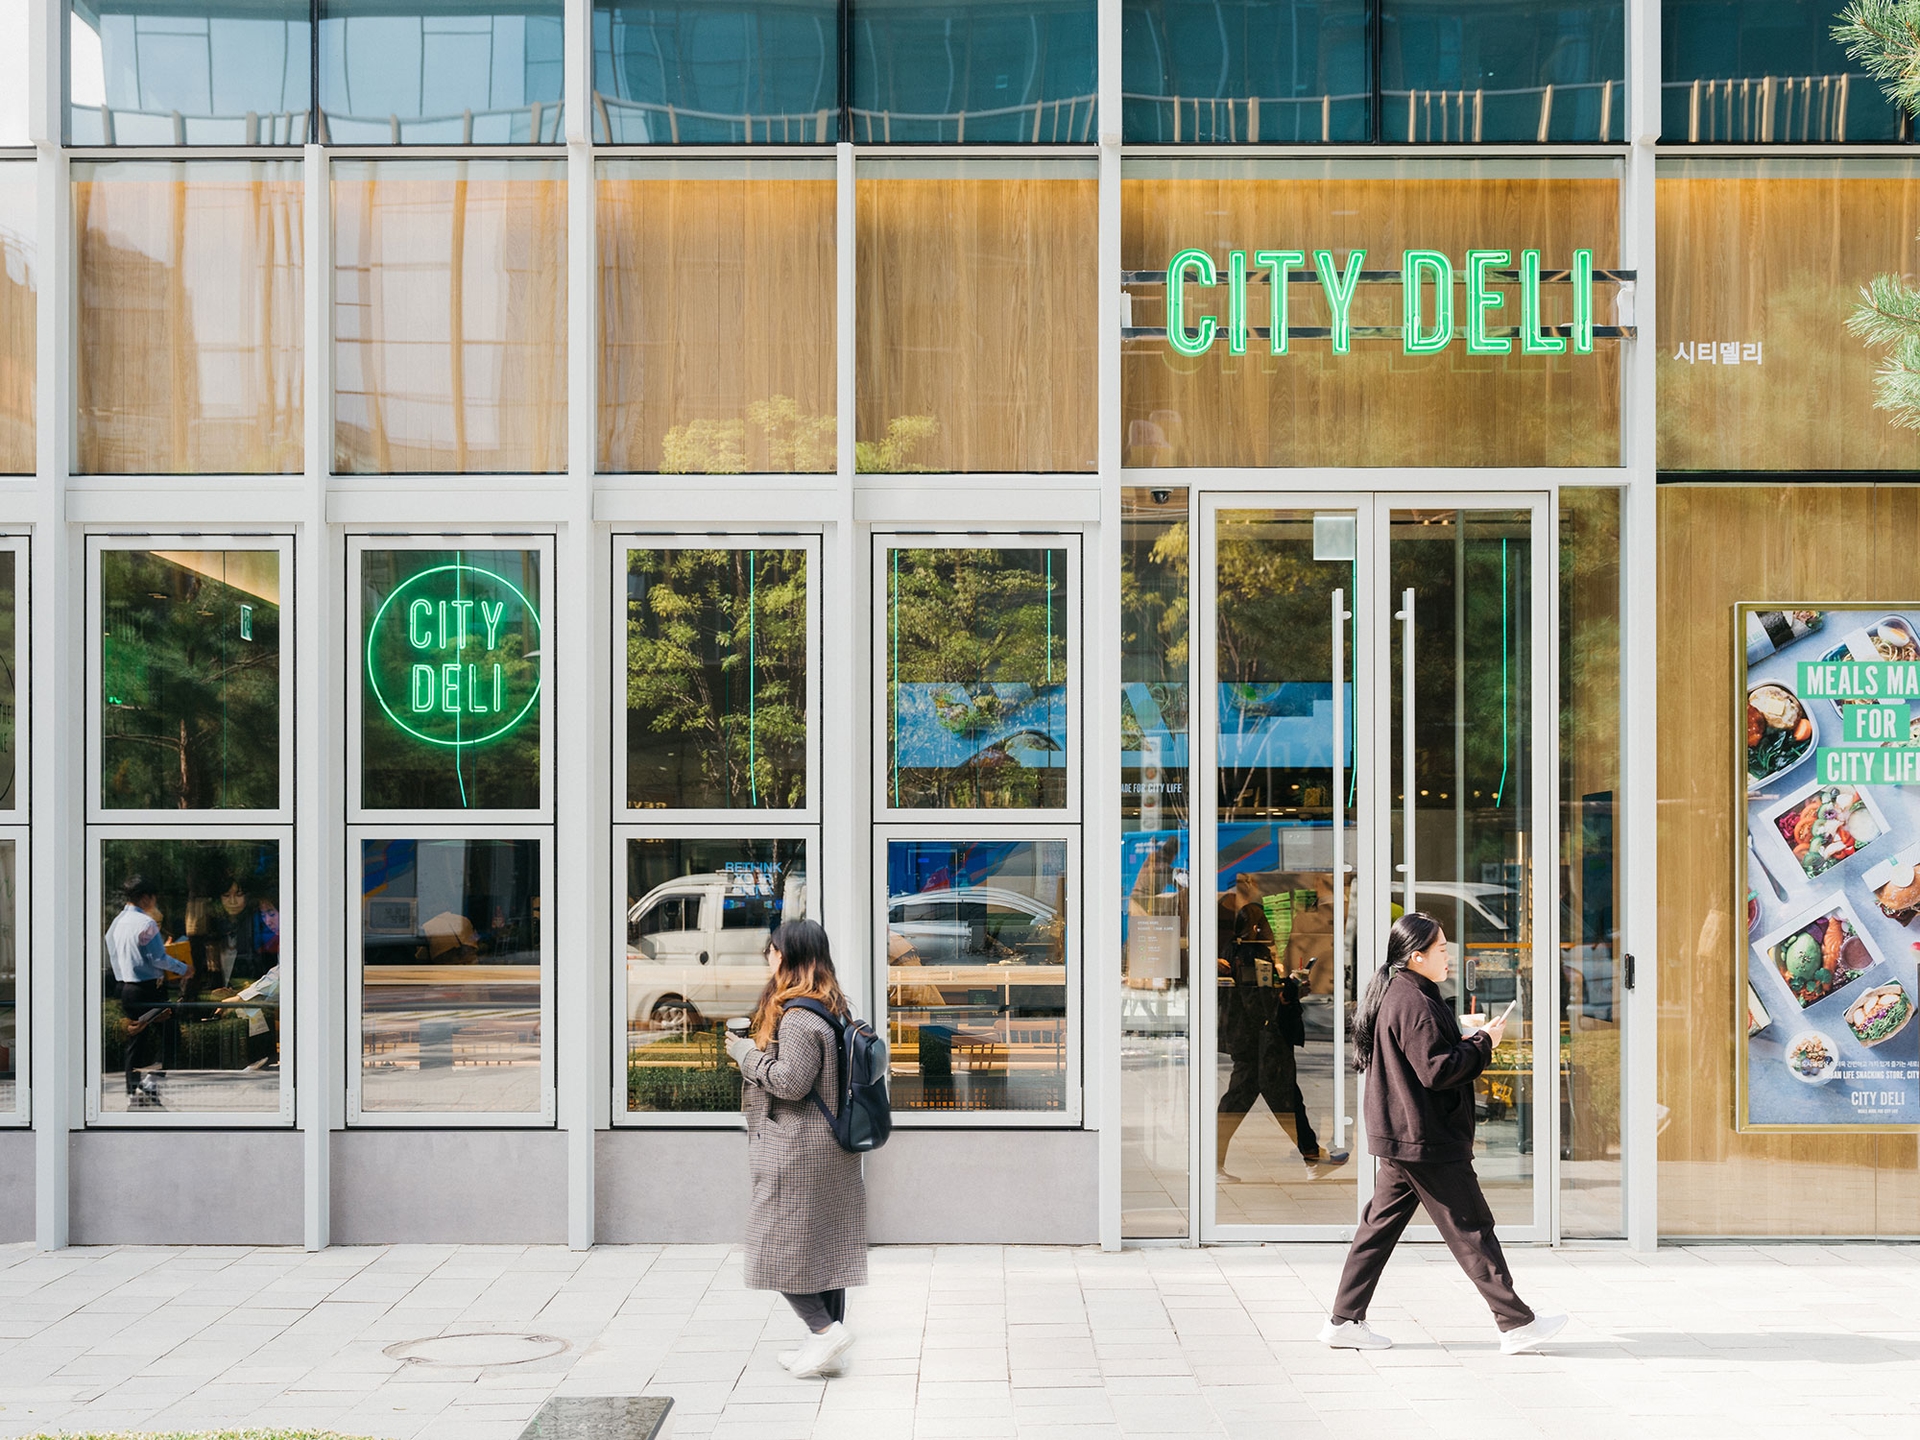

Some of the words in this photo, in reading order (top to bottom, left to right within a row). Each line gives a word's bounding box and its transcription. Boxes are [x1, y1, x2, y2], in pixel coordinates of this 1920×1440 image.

[1166, 248, 1367, 357] CITY
[1402, 248, 1594, 356] DELI
[1673, 341, 1763, 365] 시티델리
[409, 598, 504, 650] CITY
[412, 663, 501, 713] DELI
[1807, 665, 1878, 695] MEALS
[1887, 665, 1919, 695] MA
[1856, 708, 1897, 738] FOR
[1826, 752, 1875, 782] CITY
[1133, 783, 1146, 793] FOR
[1148, 783, 1165, 793] CITY
[1166, 783, 1182, 793] LIFE
[1851, 1091, 1877, 1106] CITY
[1880, 1091, 1905, 1106] DELI
